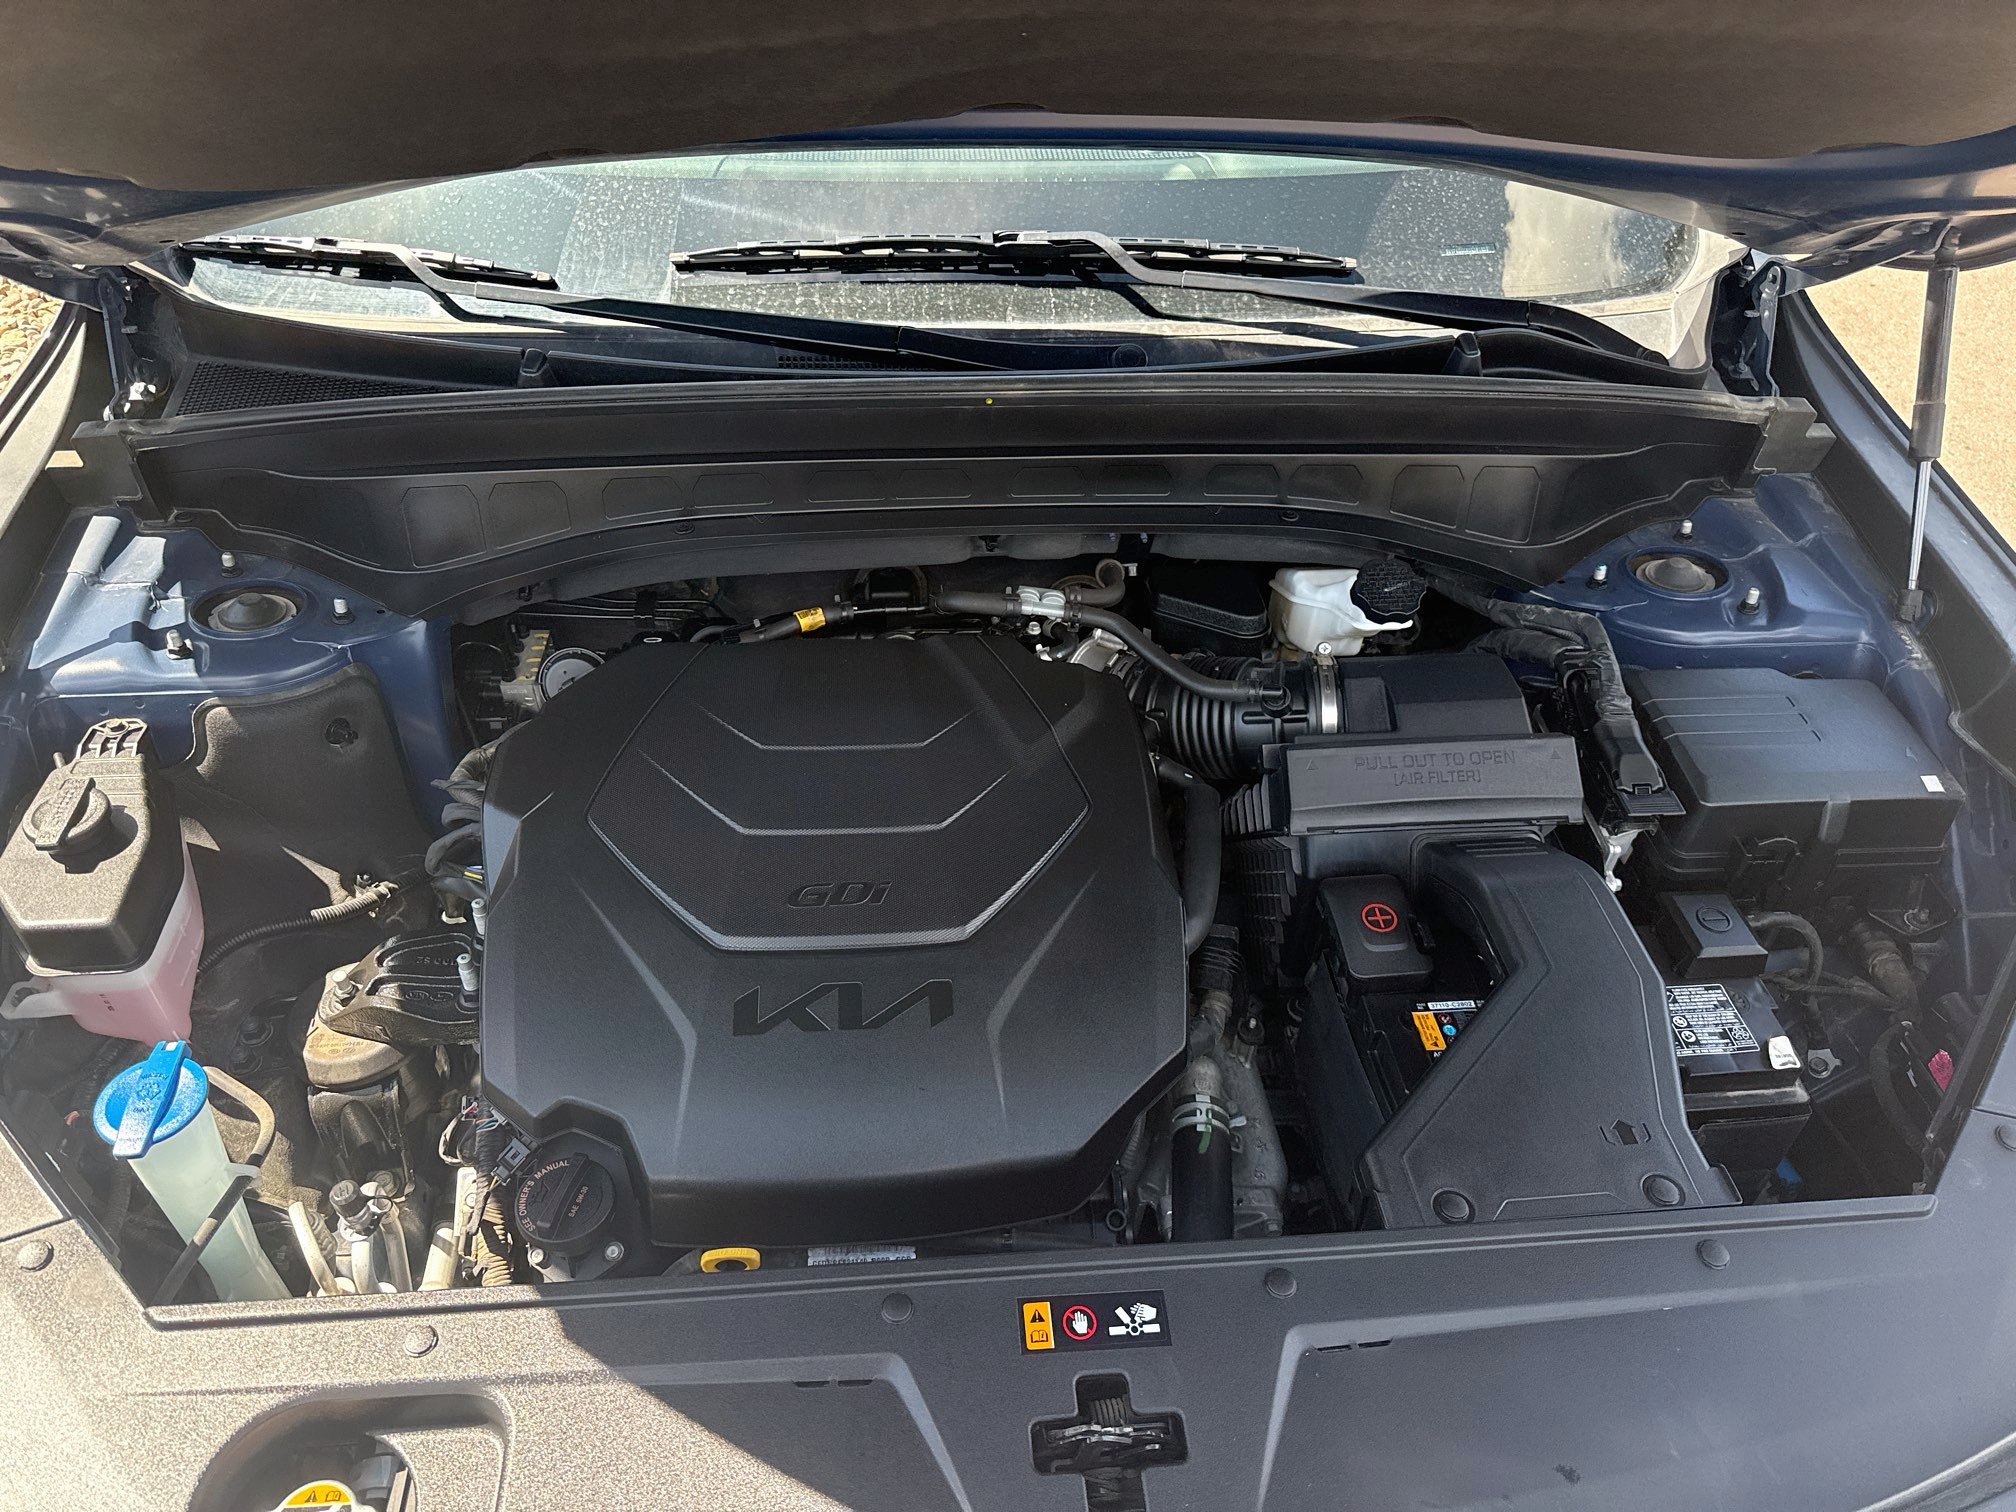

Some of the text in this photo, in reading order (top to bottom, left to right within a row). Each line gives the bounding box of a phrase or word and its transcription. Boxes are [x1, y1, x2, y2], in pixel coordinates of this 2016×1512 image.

[1355, 750, 1515, 770] PULL OUT TO OPEN
[733, 979, 954, 1036] KIA
[518, 1160, 570, 1232] SEE OWNER'S MANUAL
[568, 1205, 579, 1218] SAE
